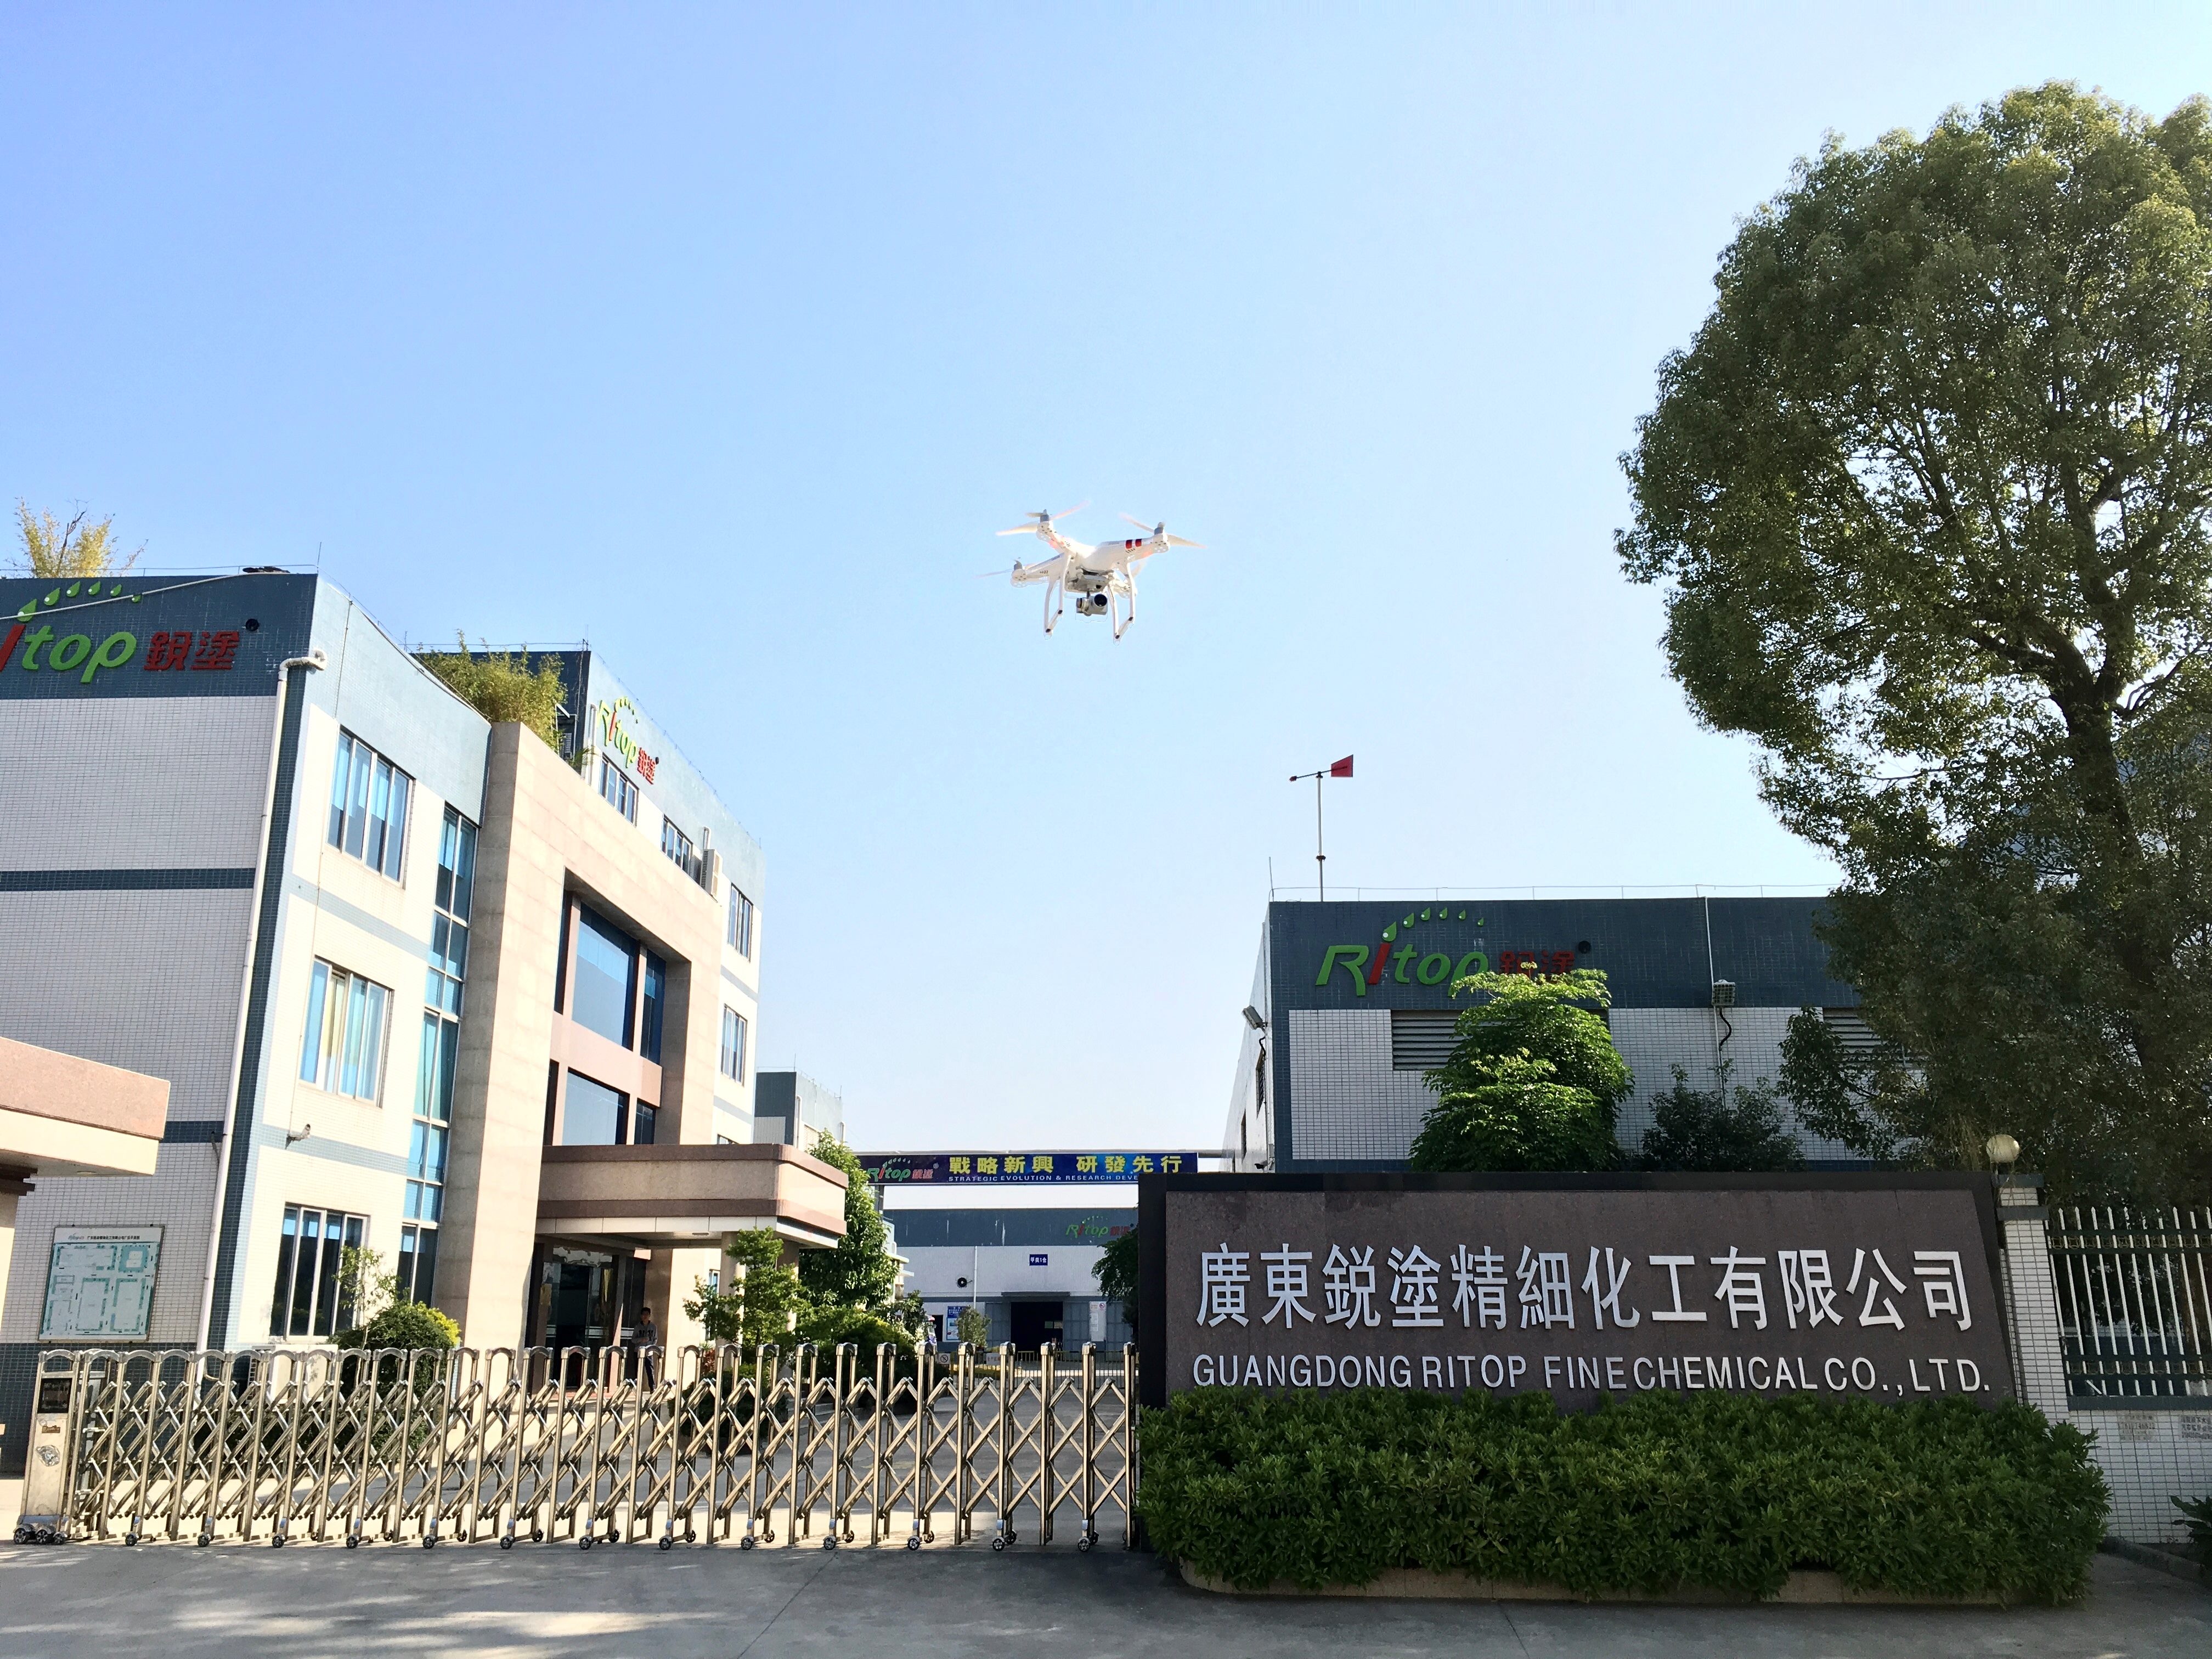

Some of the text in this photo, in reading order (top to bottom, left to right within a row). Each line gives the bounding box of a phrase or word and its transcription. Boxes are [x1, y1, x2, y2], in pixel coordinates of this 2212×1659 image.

[949, 1156, 1053, 1174] 戰略新興
[1076, 1155, 1182, 1173] 研發先行
[867, 1167, 911, 1182] Ritop
[1193, 1354, 1411, 1387] GUANGDONG
[1423, 1355, 1527, 1388] RITOP
[1544, 1356, 1627, 1389] FINE
[1633, 1356, 1818, 1390] CHEMICAL
